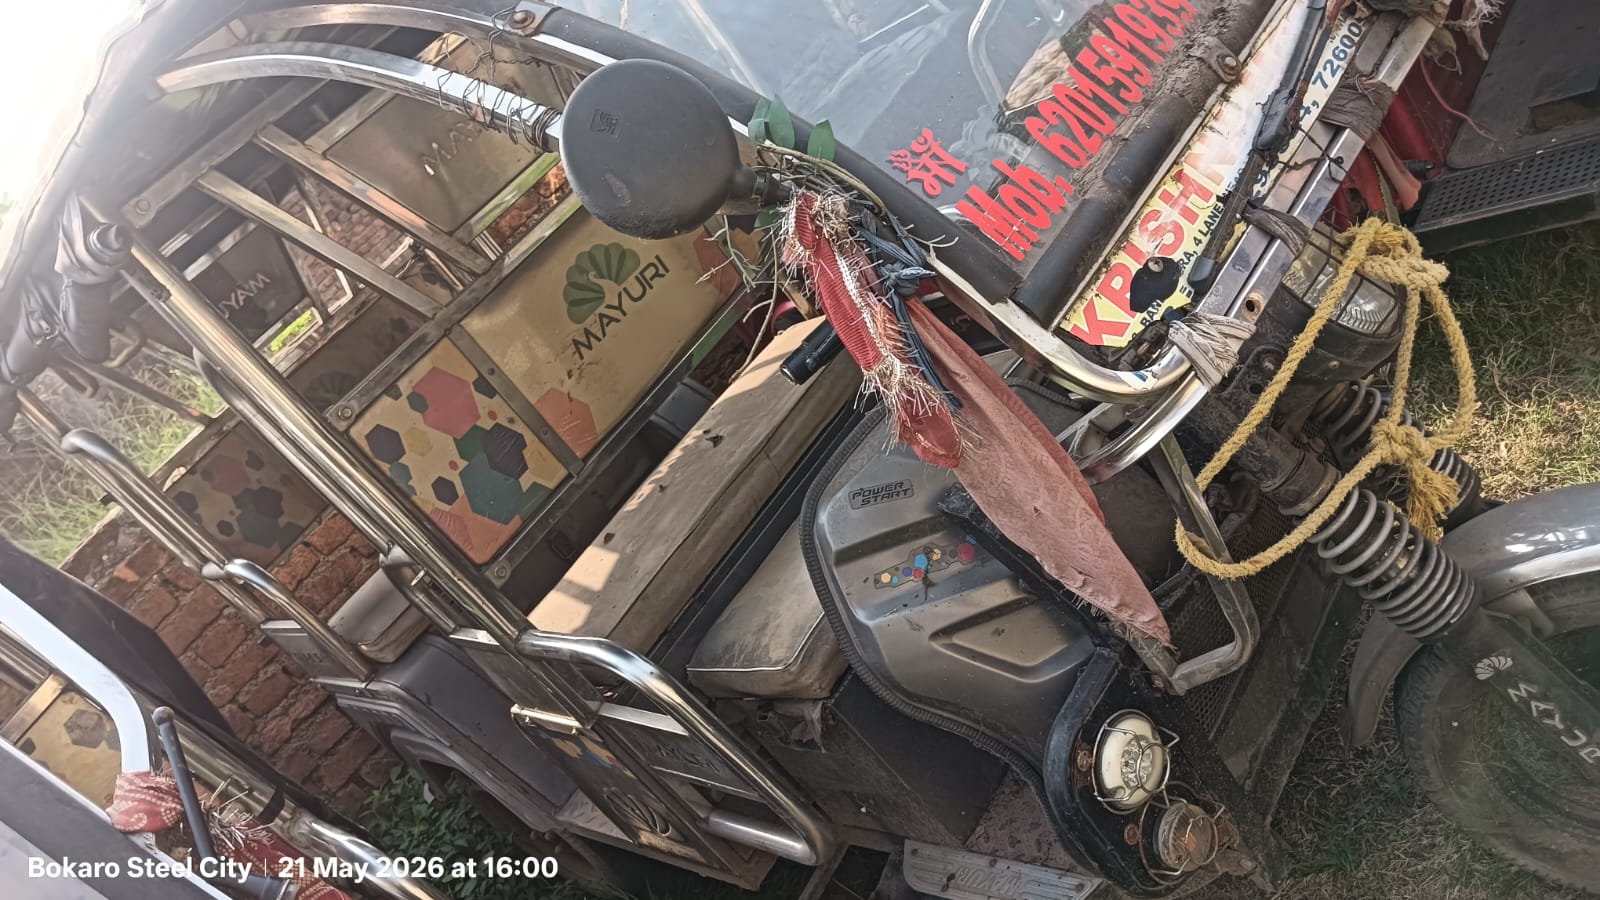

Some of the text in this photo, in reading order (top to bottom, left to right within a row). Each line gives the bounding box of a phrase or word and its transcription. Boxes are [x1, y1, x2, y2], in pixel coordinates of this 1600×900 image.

[1193, 235, 1203, 247] 4
[571, 254, 670, 361] MAYURI
[852, 481, 904, 500] POWER
[860, 487, 911, 506] START
